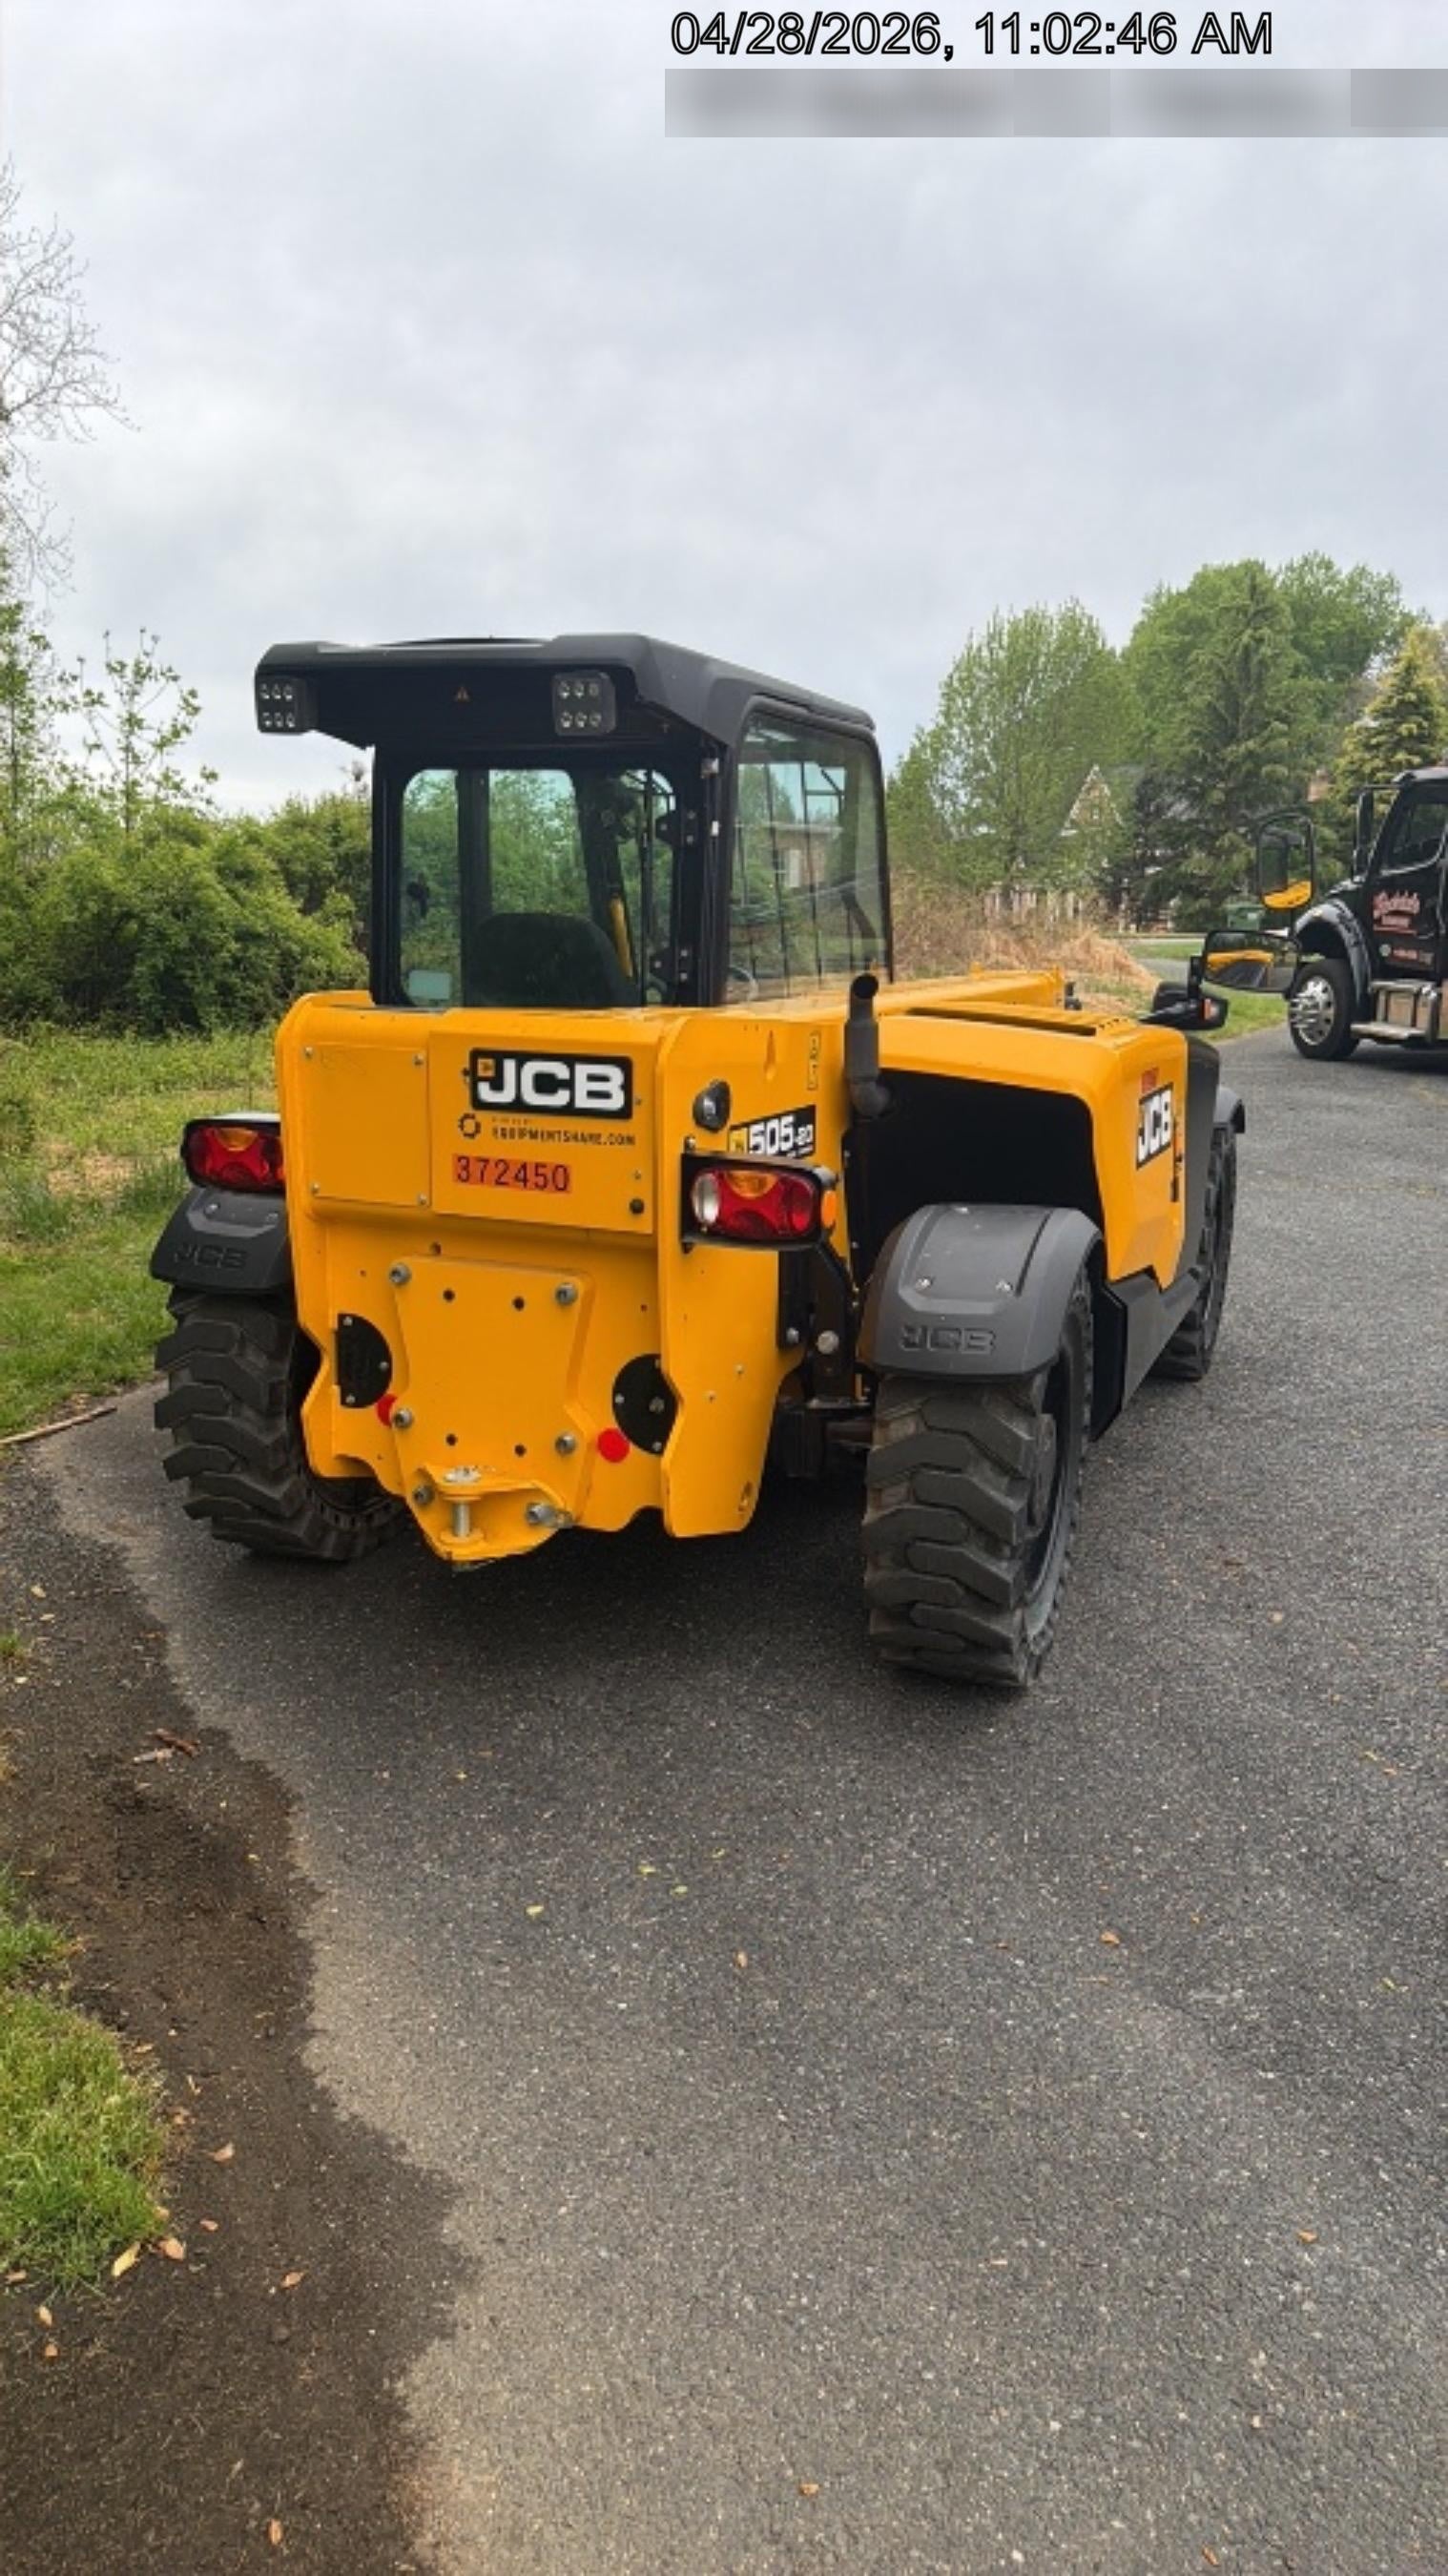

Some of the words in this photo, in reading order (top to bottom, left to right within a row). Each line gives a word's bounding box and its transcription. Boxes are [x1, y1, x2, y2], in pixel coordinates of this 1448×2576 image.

[476, 1058, 625, 1111] JCB
[1137, 1088, 1172, 1163] JCB
[456, 1154, 569, 1192] 372450
[173, 1243, 248, 1269] JCB
[900, 1326, 996, 1355] JCB
